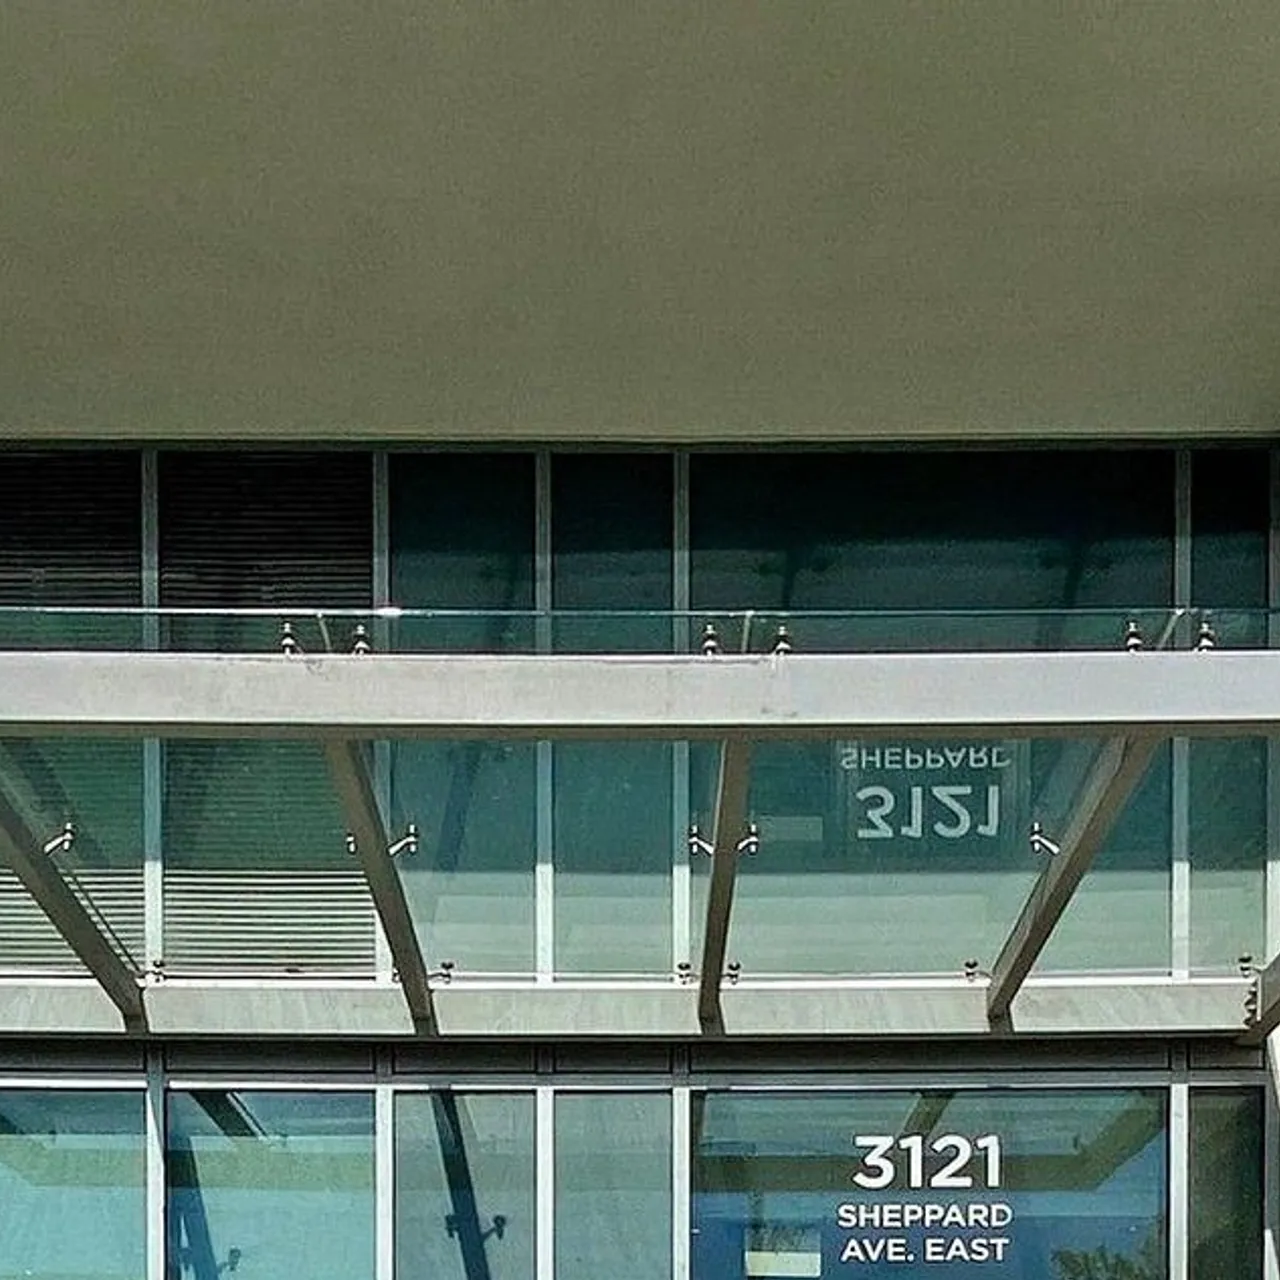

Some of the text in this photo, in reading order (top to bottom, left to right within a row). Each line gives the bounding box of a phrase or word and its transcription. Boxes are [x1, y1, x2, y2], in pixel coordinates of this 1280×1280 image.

[853, 1135, 1001, 1188] 3121
[838, 1204, 1012, 1228] SHEPPARD
[841, 1238, 1009, 1262] AVE. EAST
